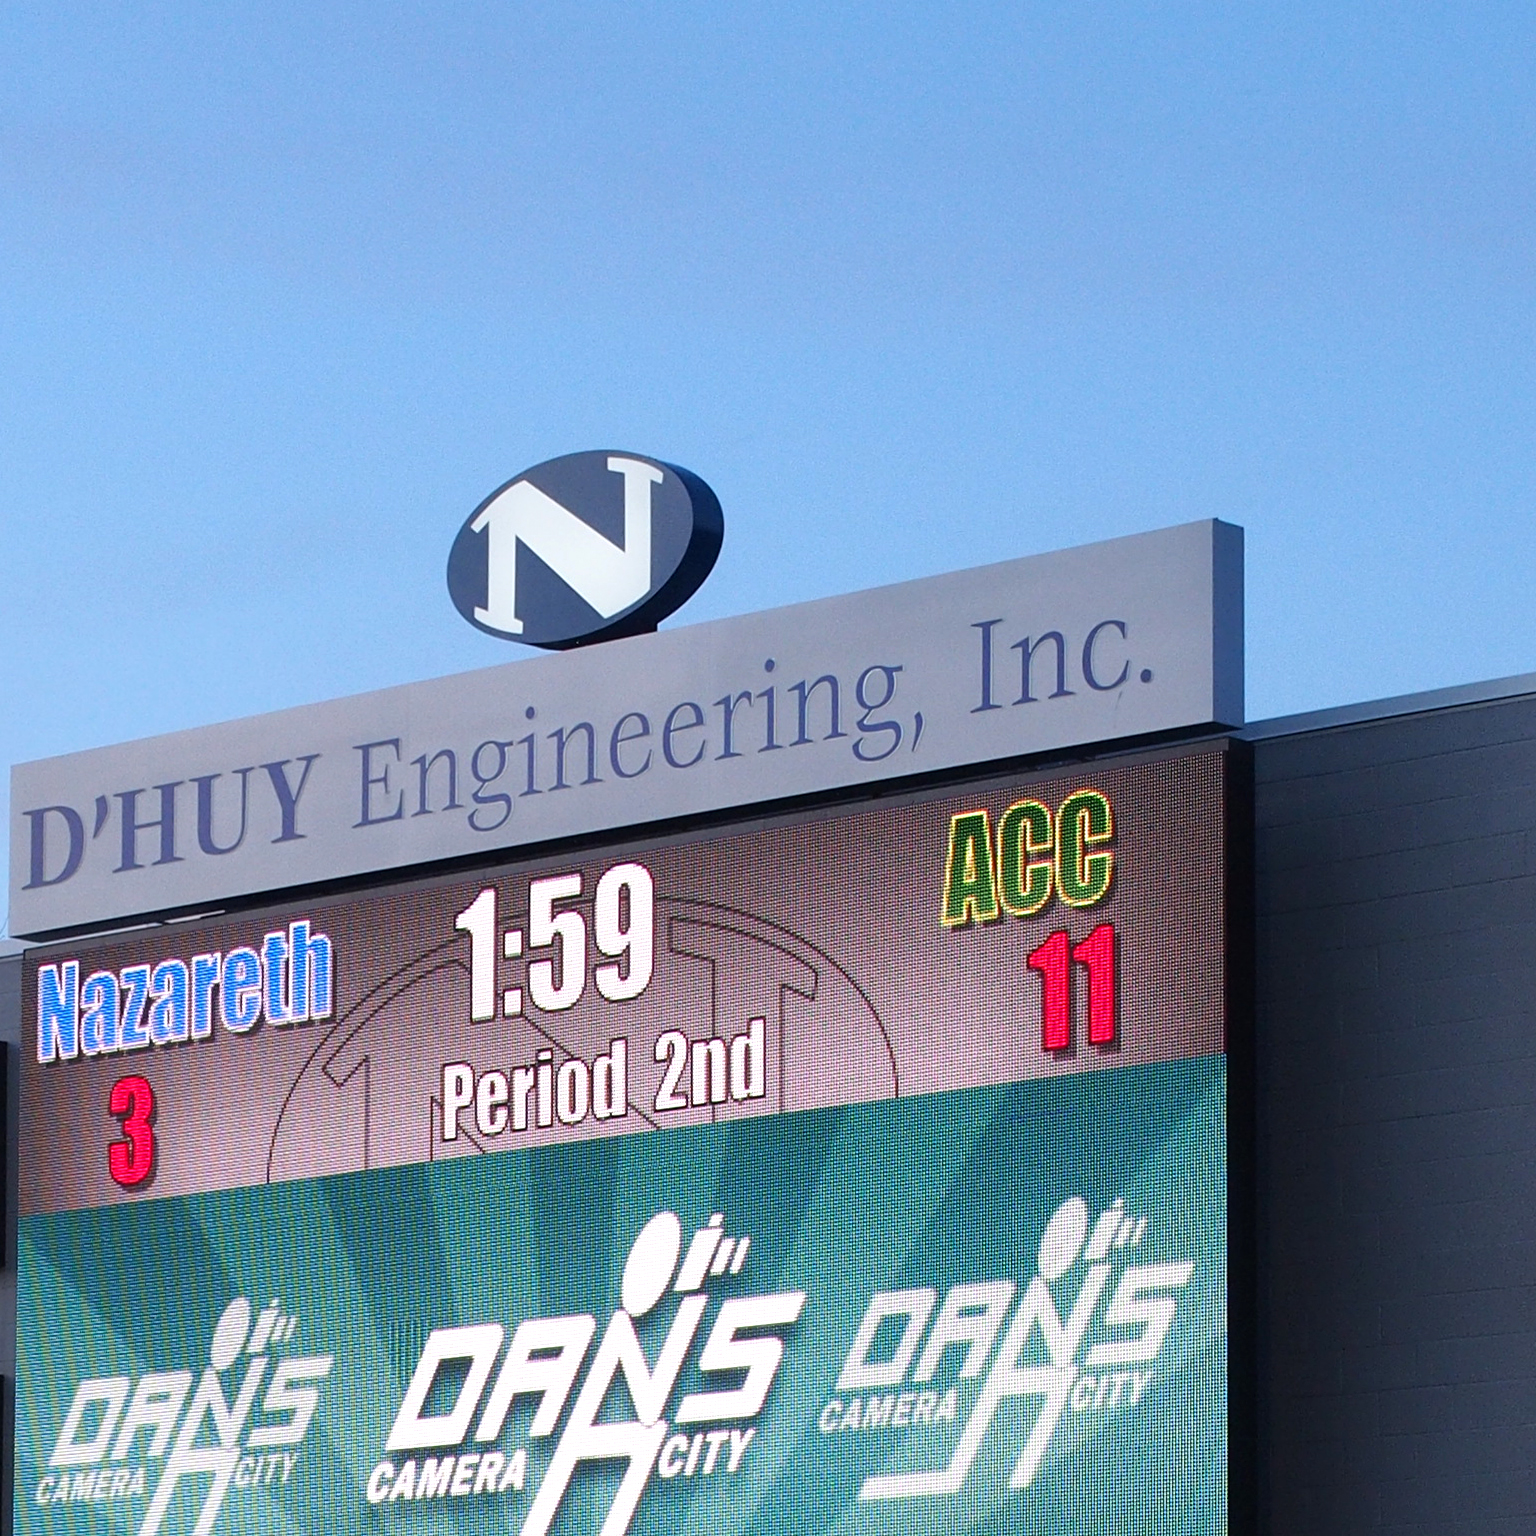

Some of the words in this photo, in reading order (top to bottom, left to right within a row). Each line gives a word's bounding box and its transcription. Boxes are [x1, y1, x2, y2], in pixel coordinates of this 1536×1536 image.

[470, 456, 663, 635] N
[20, 754, 322, 893] D'HUY
[352, 657, 926, 833] Engineering,
[970, 617, 1156, 714] Inc.
[941, 788, 1114, 929] ACC
[36, 920, 333, 1066] Nazareth
[454, 862, 656, 1025] 1:59
[1026, 923, 1122, 1052] 11
[107, 1074, 156, 1187] 3
[440, 1053, 629, 1144] Period
[651, 1018, 767, 1106] 2nd
[818, 1388, 959, 1434] CAMERA
[1070, 1365, 1154, 1411] CITY
[35, 1467, 147, 1503] CAMERA
[234, 1451, 297, 1487] CITY
[366, 1448, 528, 1502] CAMERA
[658, 1427, 758, 1479] CITY
